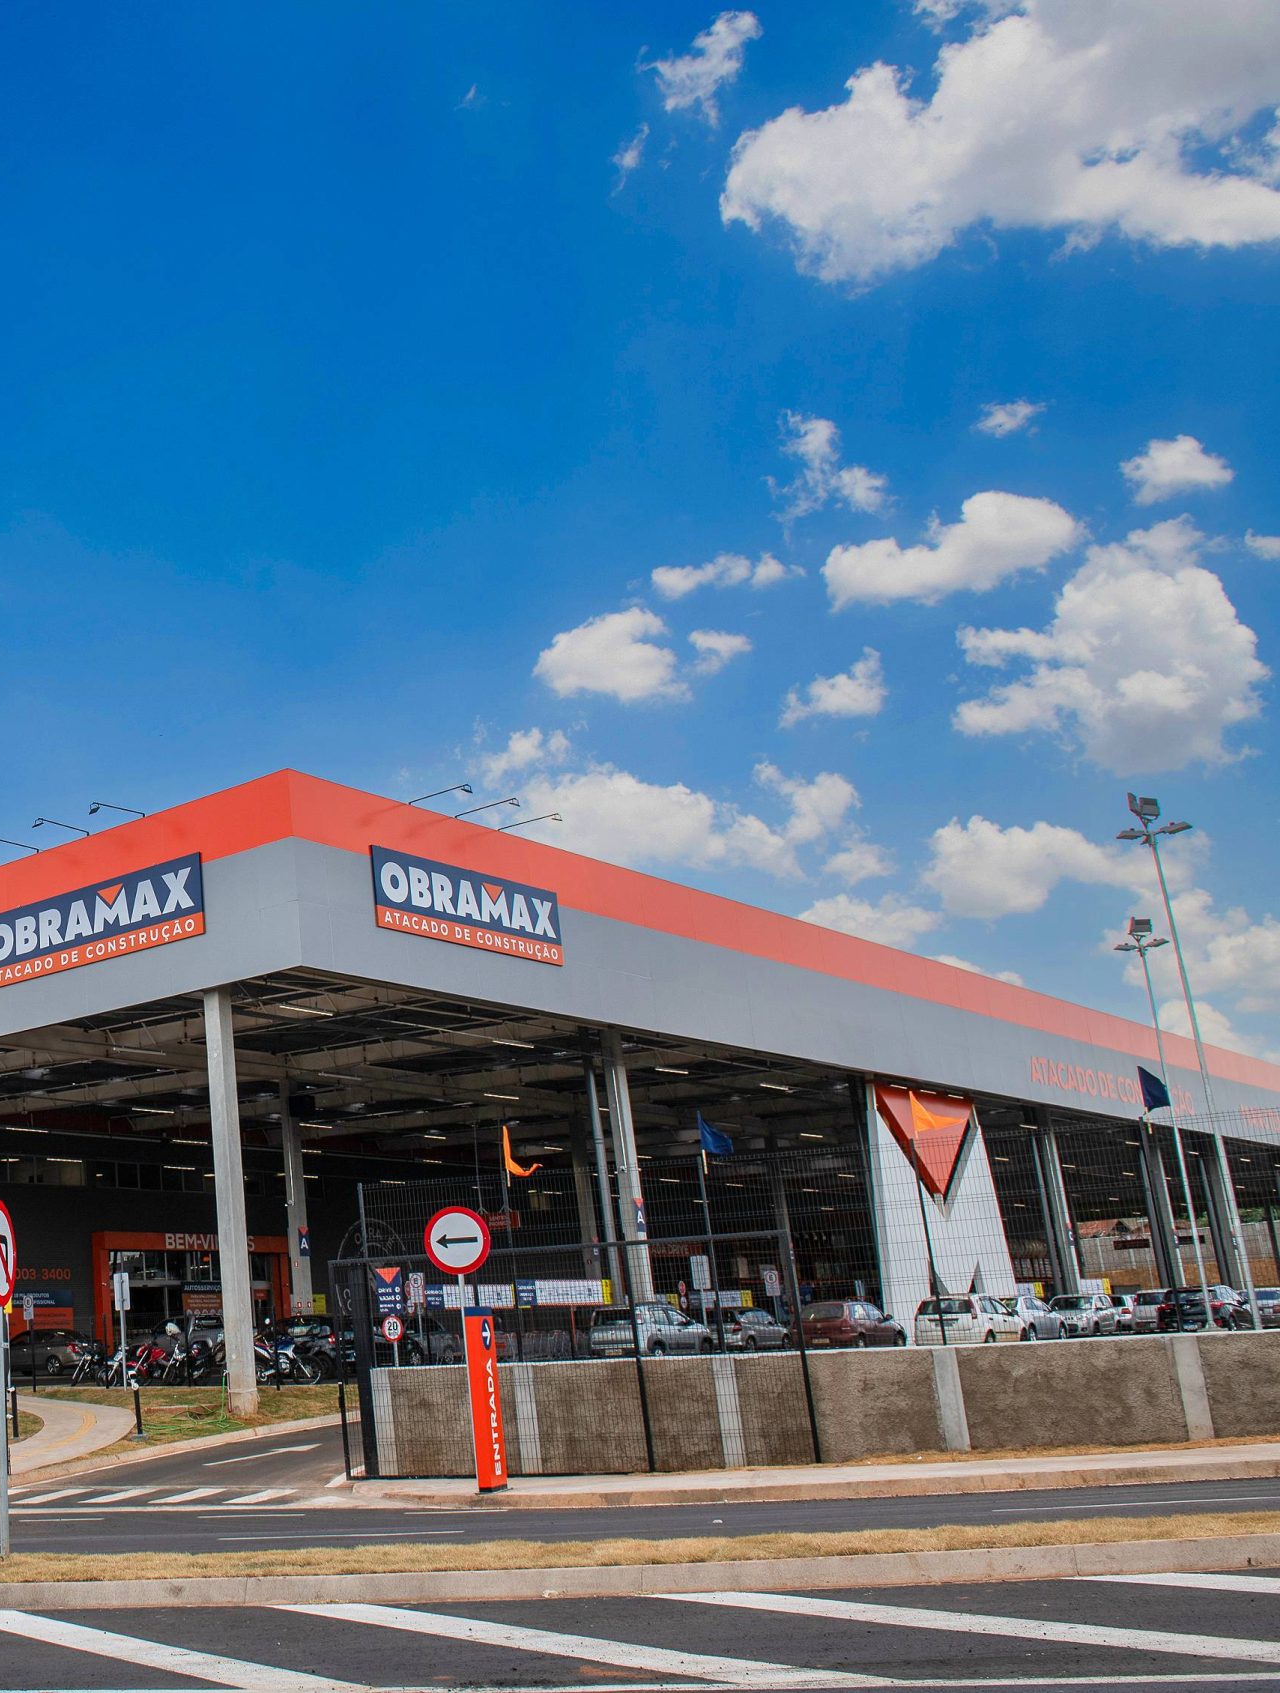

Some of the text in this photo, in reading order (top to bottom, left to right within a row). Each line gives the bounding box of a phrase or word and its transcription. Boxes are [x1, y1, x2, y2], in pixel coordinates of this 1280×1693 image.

[380, 861, 557, 939] OBRAMAX
[60, 952, 79, 966] DE
[86, 918, 196, 959] CONSTRUÇÃO
[384, 911, 559, 960] ATACADO DE CONSTRUÇÃO
[1030, 1055, 1097, 1097] ATACADO
[1097, 1071, 1118, 1098] DE
[637, 1211, 645, 1224] A
[300, 1239, 309, 1249] A
[42, 1268, 71, 1280] 3400
[386, 1321, 398, 1331] 20
[486, 1357, 502, 1475] ENTRADA
